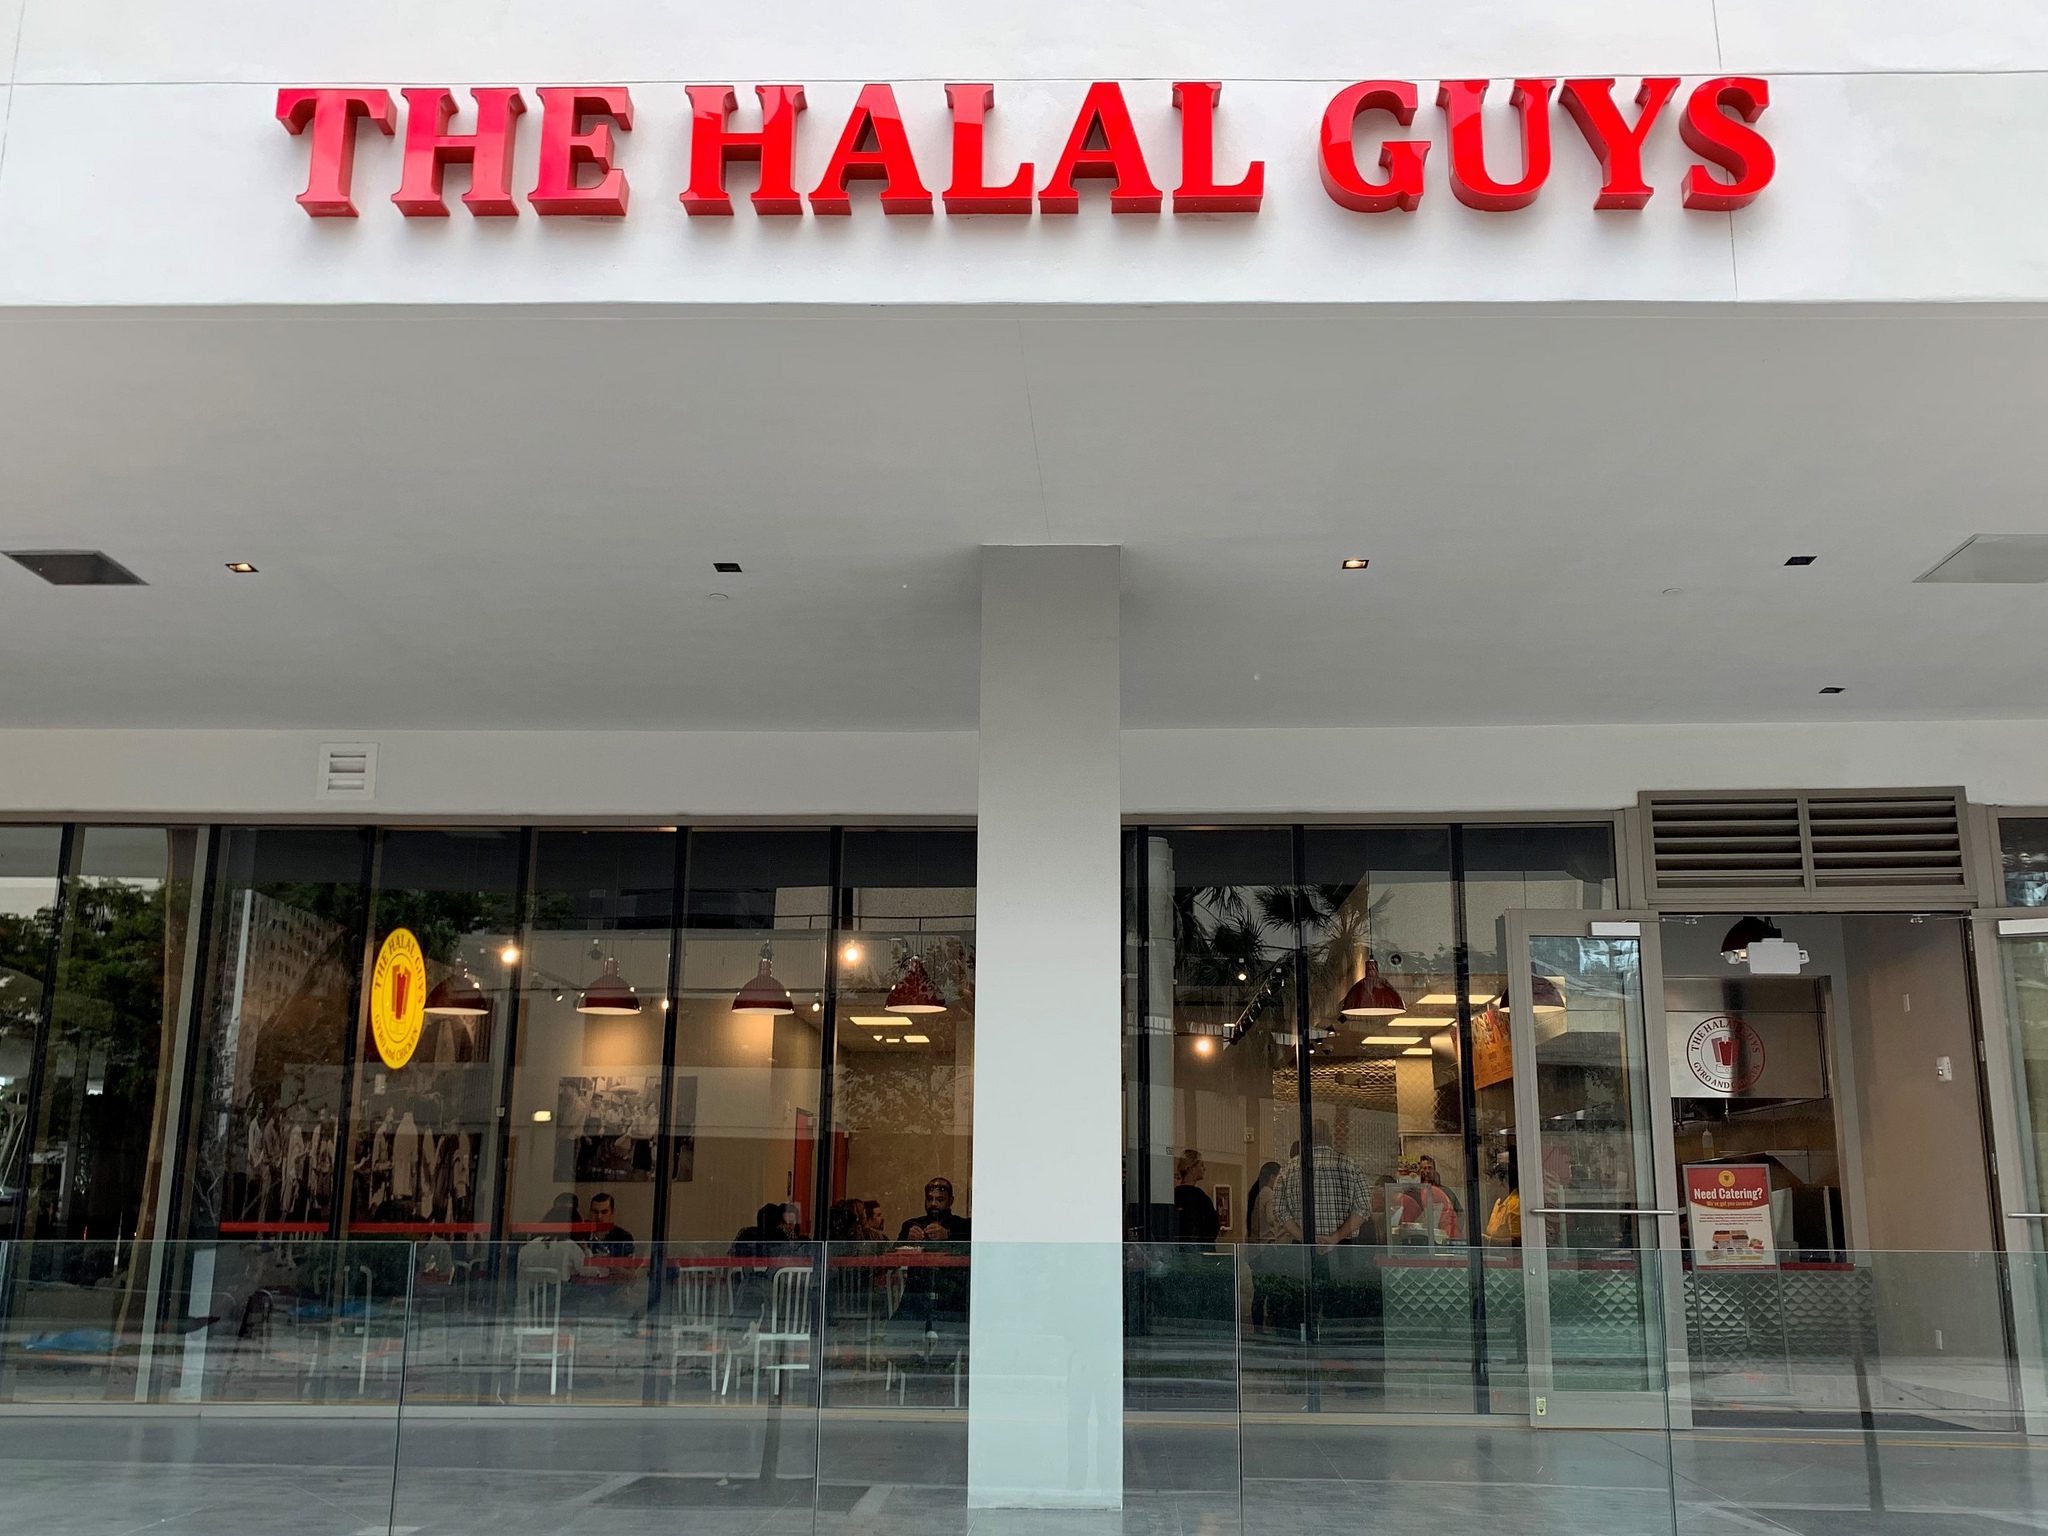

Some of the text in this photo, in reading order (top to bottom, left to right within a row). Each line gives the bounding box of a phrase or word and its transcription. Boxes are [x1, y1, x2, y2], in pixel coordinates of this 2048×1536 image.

[277, 77, 1776, 217] THE HALAL GUYS
[374, 951, 389, 990] THE
[388, 933, 414, 959] HALAL
[1691, 1029, 1706, 1052] THE
[1703, 1019, 1742, 1034] HALA
[1693, 1061, 1712, 1082] GYRO
[1710, 1079, 1730, 1089] AND
[1694, 1187, 1763, 1201] Need Catering?
